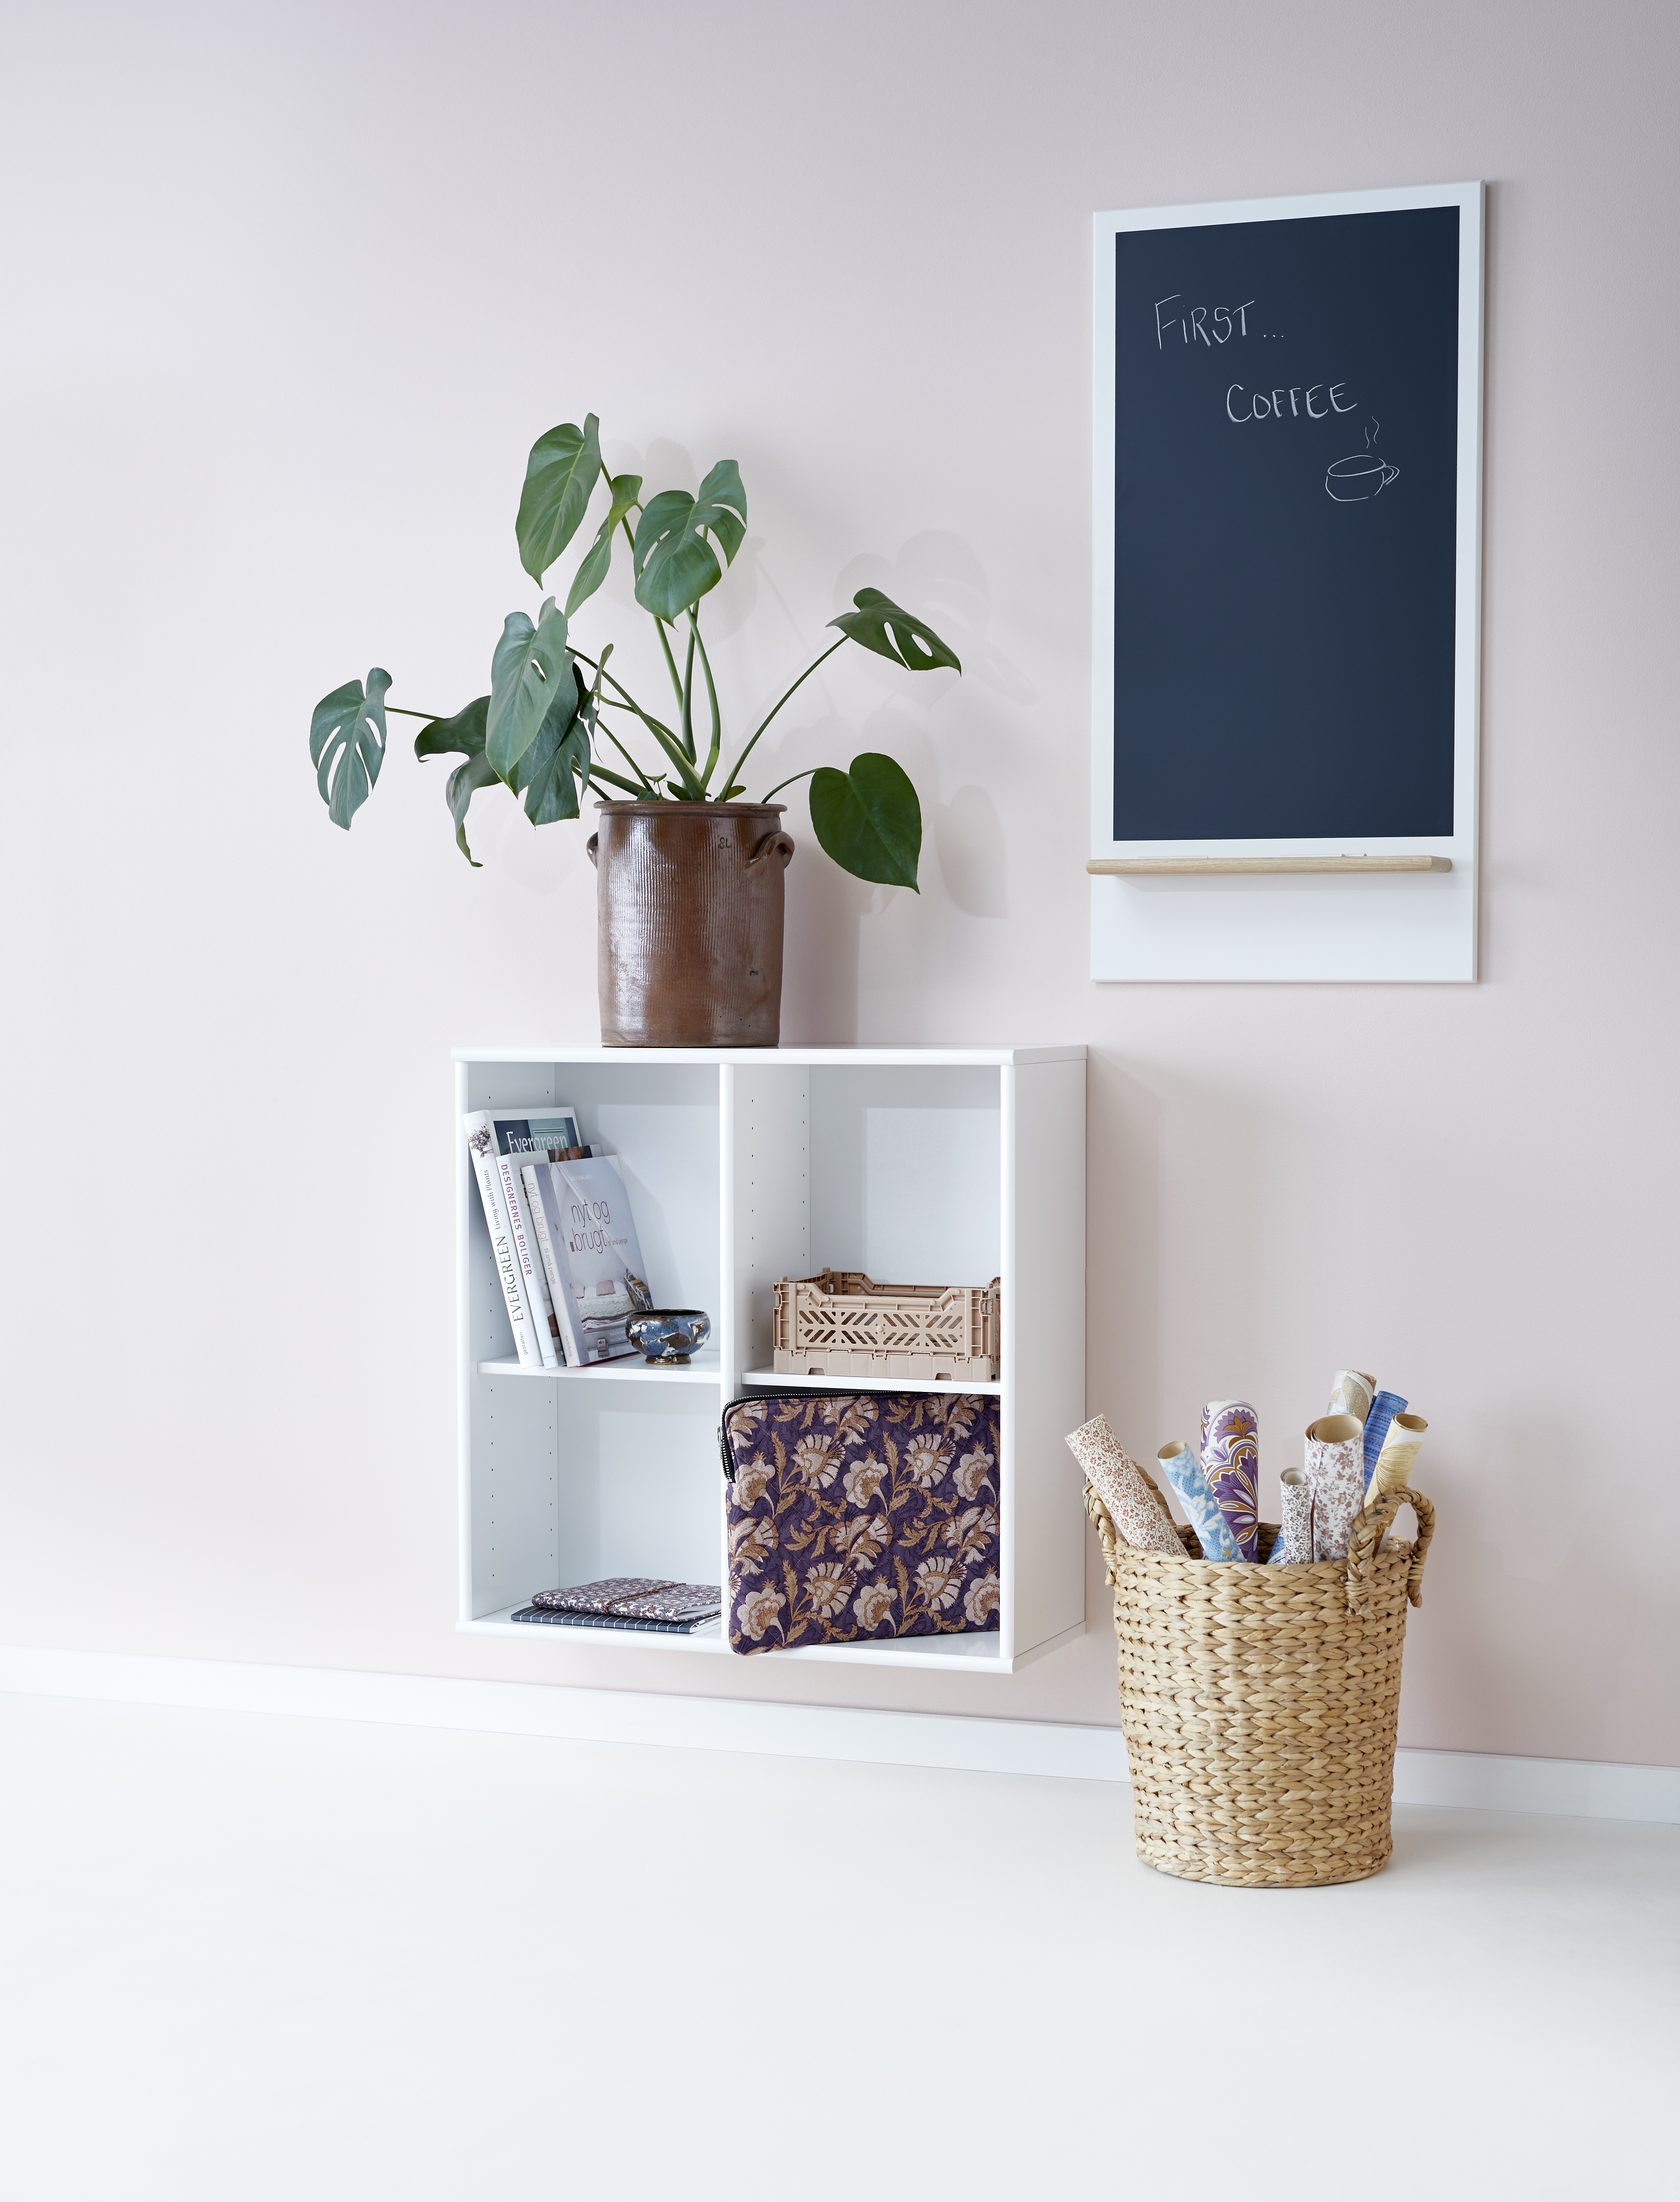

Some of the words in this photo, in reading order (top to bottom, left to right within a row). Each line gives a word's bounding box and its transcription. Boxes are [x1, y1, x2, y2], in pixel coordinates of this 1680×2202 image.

[1227, 383, 1358, 423] COFFEE
[719, 837, 731, 849] 8L
[484, 1170, 492, 1191] Plants
[527, 1183, 538, 1198] nyt
[487, 1192, 496, 1207] with
[532, 1201, 540, 1214] og
[492, 1209, 501, 1229] Living
[501, 1164, 522, 1230] DESIGNERNES
[517, 1234, 532, 1275] BOLIGER
[571, 1199, 591, 1227] nyt
[593, 1201, 610, 1224] og
[536, 1216, 549, 1243] brugt
[572, 1225, 607, 1254] brugt
[495, 1236, 524, 1322] EVERGREEN
[548, 1267, 556, 1284] penge
[520, 1331, 528, 1355] gestalten
